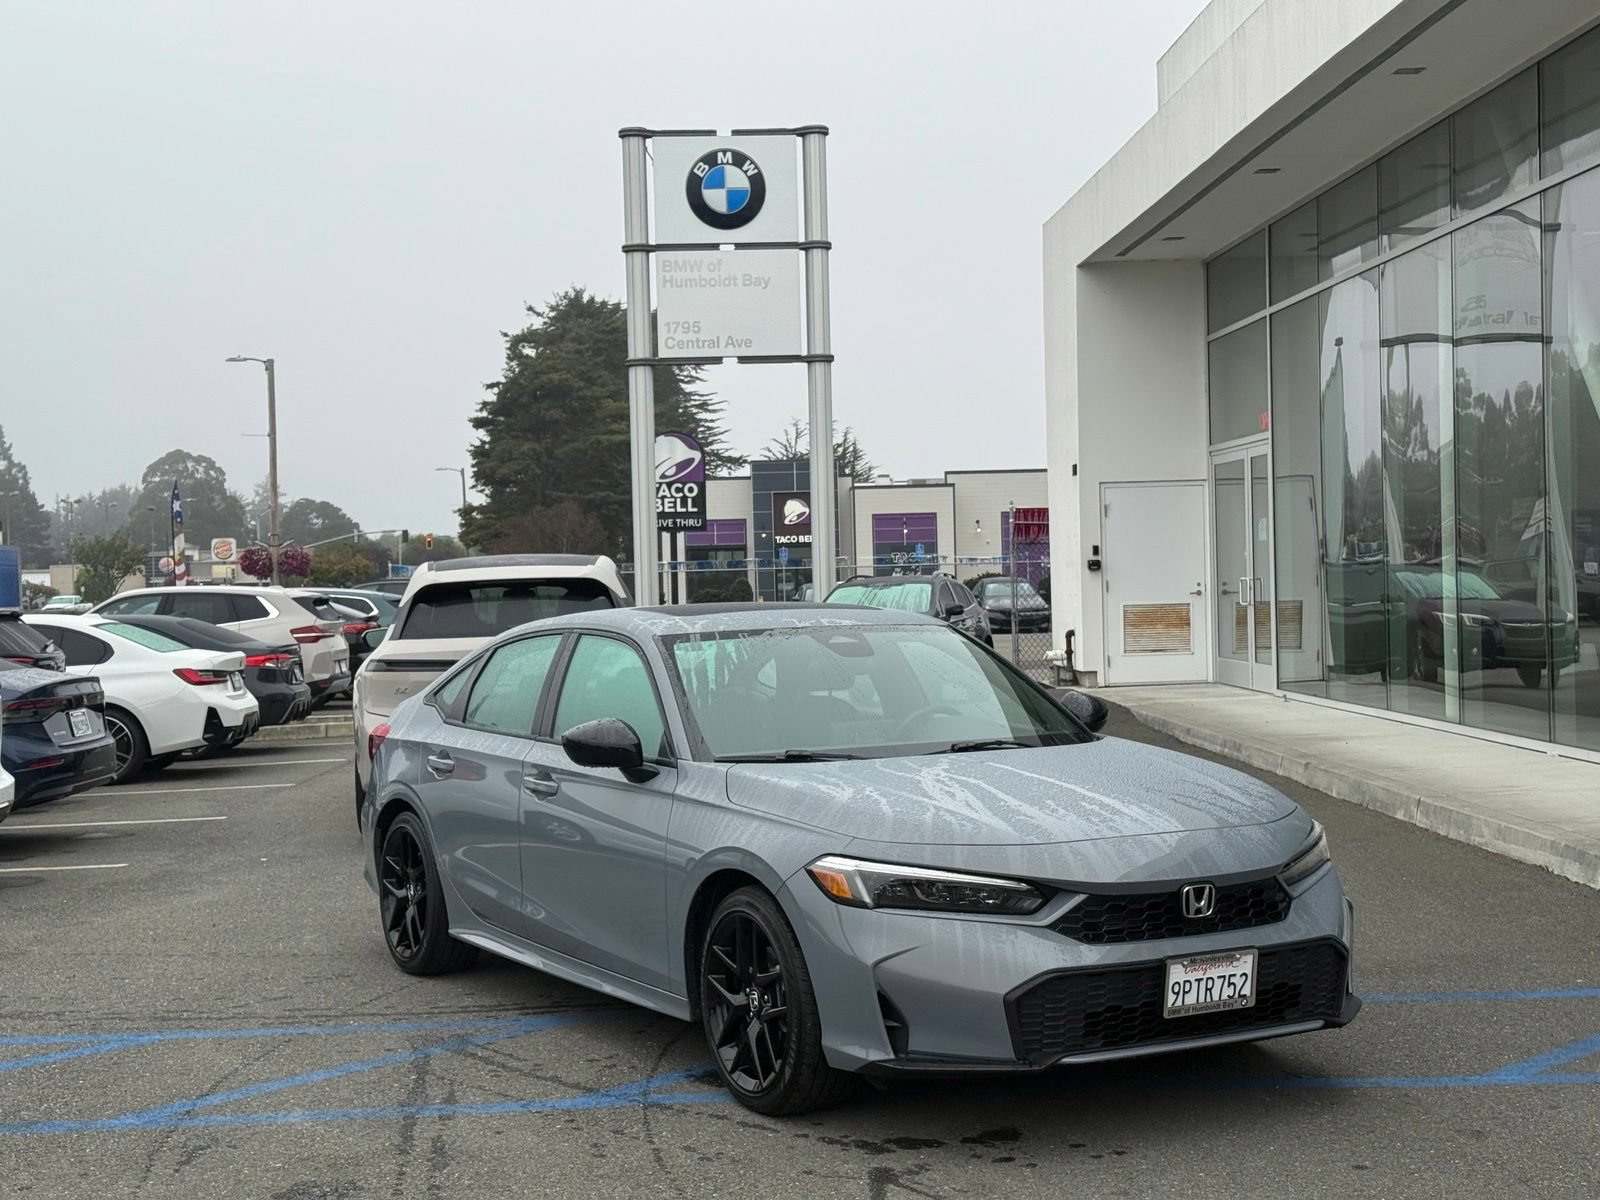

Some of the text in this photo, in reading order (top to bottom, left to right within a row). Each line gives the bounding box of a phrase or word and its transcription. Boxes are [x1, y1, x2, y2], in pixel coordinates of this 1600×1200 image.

[693, 151, 759, 178] BMW
[661, 258, 723, 273] BMW of
[661, 273, 771, 289] Humboldt Bay
[663, 321, 701, 334] 1795
[664, 335, 753, 350] Central Ave
[675, 518, 702, 527] THRU
[775, 534, 798, 544] TACO
[1171, 972, 1249, 1007] 9PTR752
